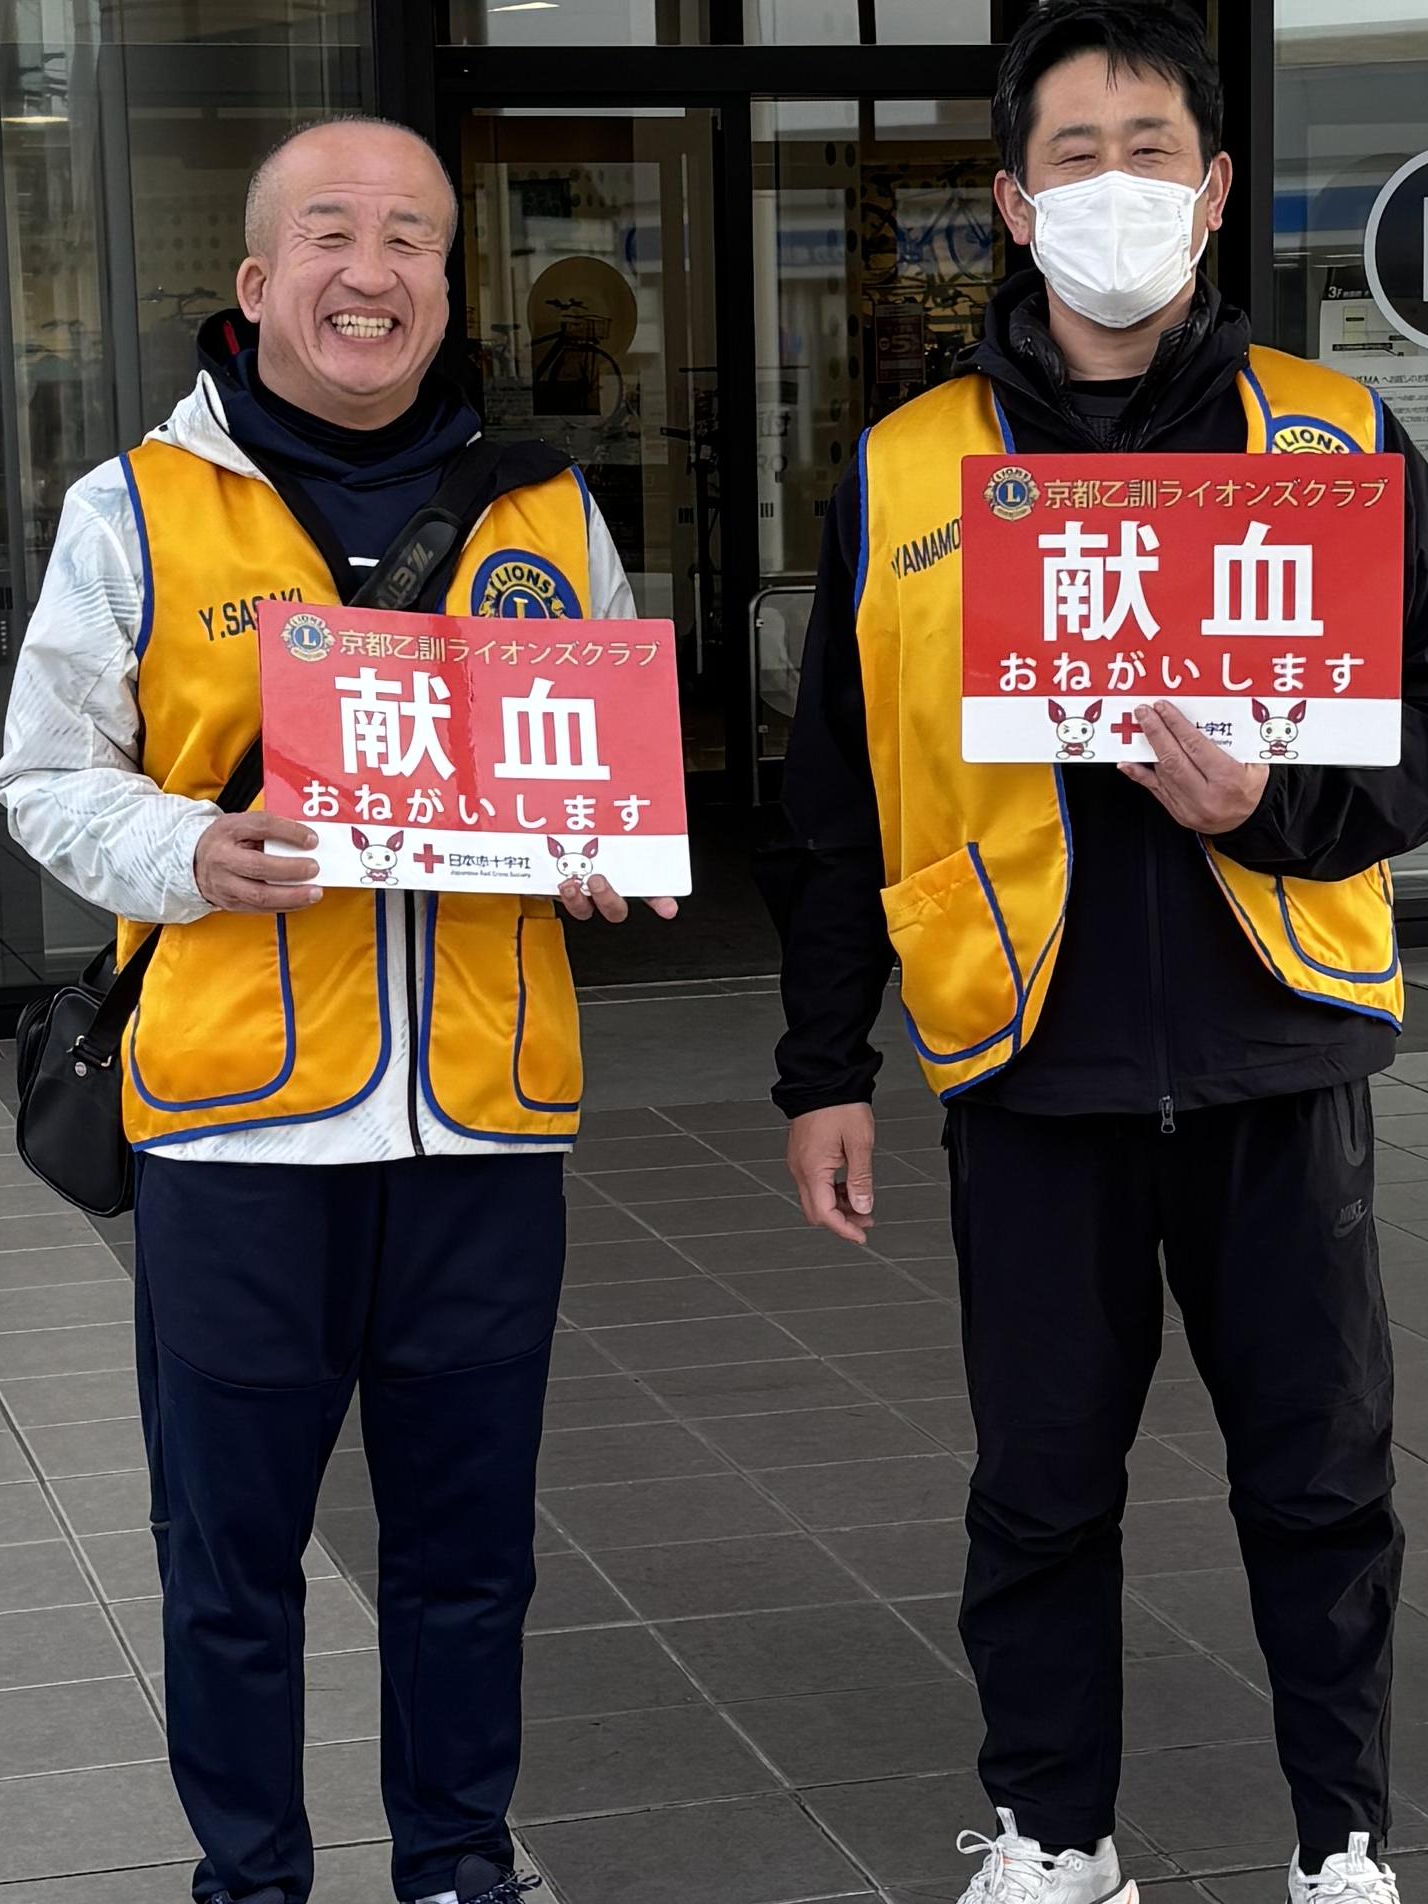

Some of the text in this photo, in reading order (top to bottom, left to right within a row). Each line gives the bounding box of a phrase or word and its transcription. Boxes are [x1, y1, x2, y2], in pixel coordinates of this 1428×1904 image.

[1043, 477, 1390, 510] 京都乙訓ライオンズクラブ
[891, 516, 963, 580] YAMAMO
[497, 564, 554, 595] LIONS
[1037, 519, 1325, 643] 献血
[338, 628, 662, 667] 京都乙訓ライオンズクラブ
[998, 651, 1366, 695] おねがいします
[334, 665, 611, 783] 献血
[301, 779, 652, 832] おねがいします
